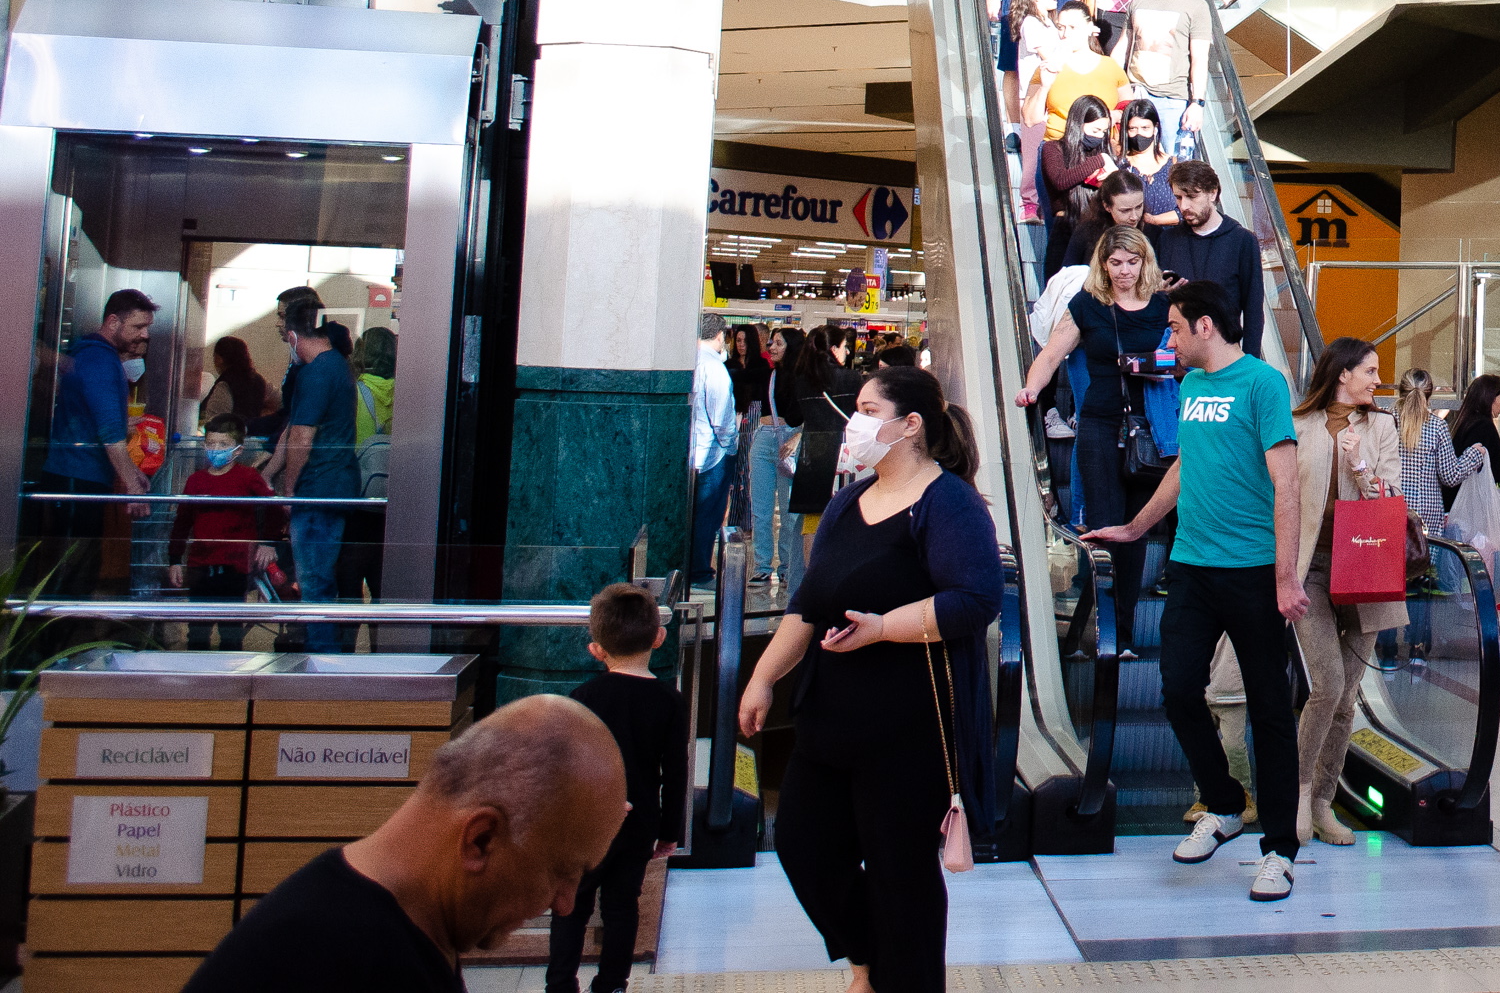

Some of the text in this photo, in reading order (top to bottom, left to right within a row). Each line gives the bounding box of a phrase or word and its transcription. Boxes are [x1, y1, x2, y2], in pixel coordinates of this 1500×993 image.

[1183, 396, 1235, 423] VANS
[100, 746, 190, 765] Reciclável
[279, 745, 408, 765] Não Reciclável
[109, 801, 171, 817] Plástico
[117, 822, 161, 839] Papel
[115, 843, 160, 858] Metal
[116, 863, 158, 879] Vidro
